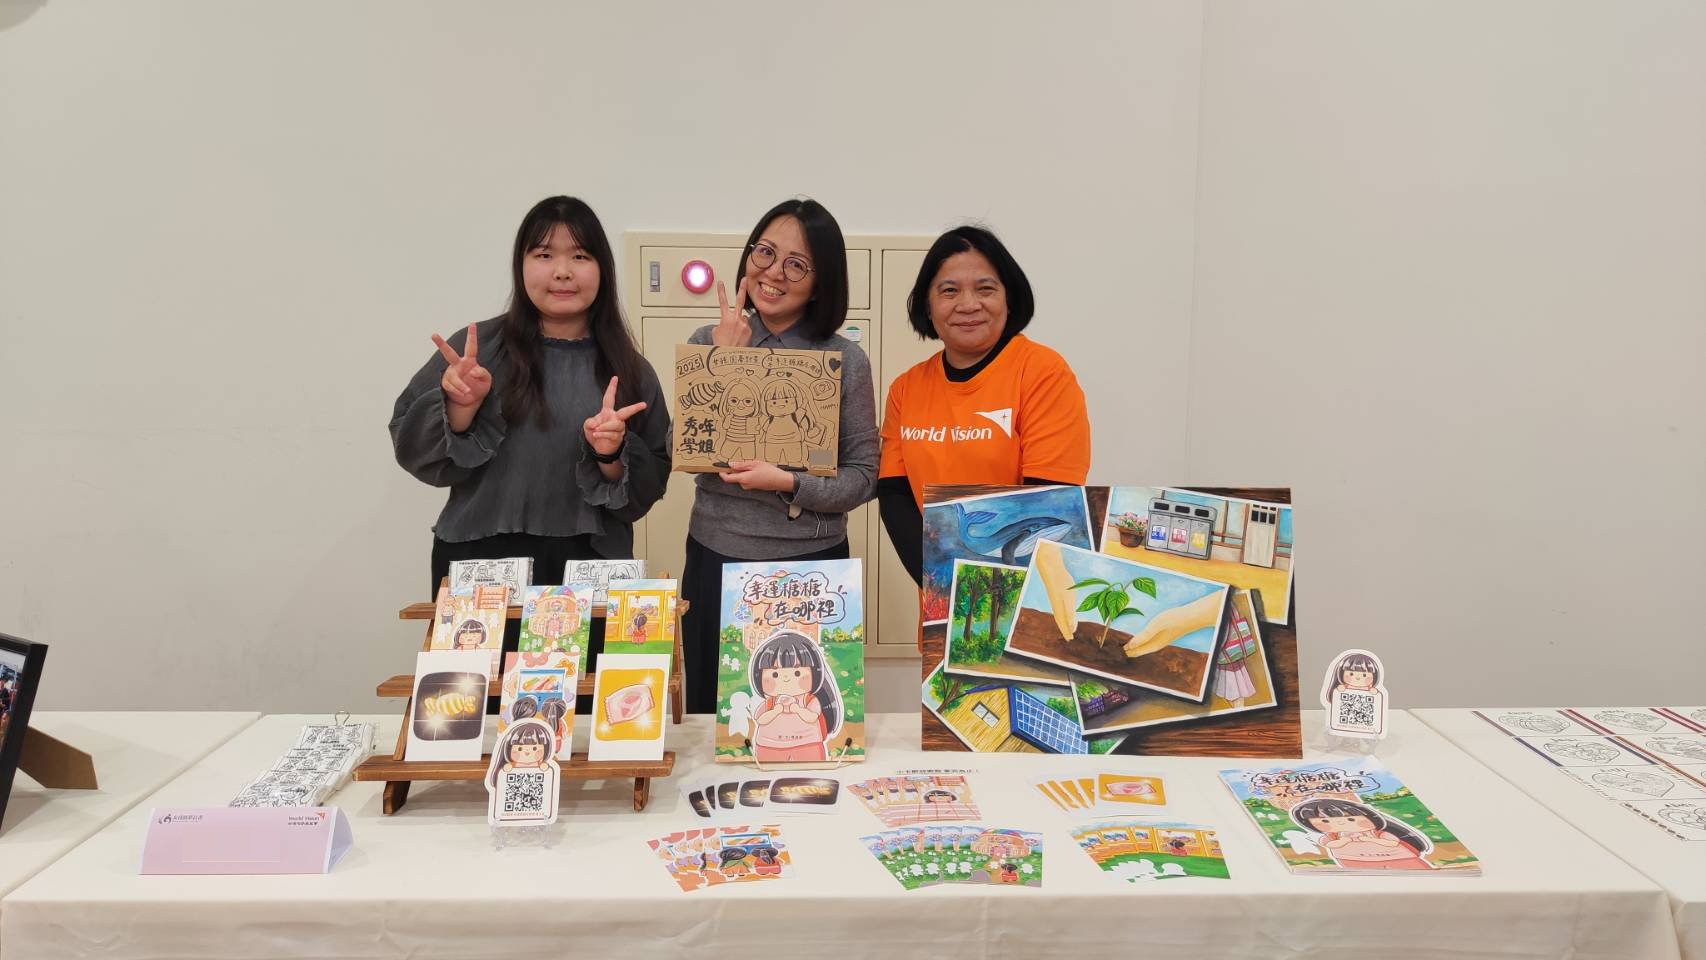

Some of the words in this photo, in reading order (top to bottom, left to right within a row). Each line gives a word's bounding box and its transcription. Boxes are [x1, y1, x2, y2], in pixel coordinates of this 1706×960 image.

[677, 358, 701, 375] 2025
[900, 426, 946, 442] World
[950, 426, 992, 443] Vision
[679, 438, 716, 455] 學姐
[748, 578, 822, 600] 幸運糖糖
[774, 599, 838, 620] 在哪裡
